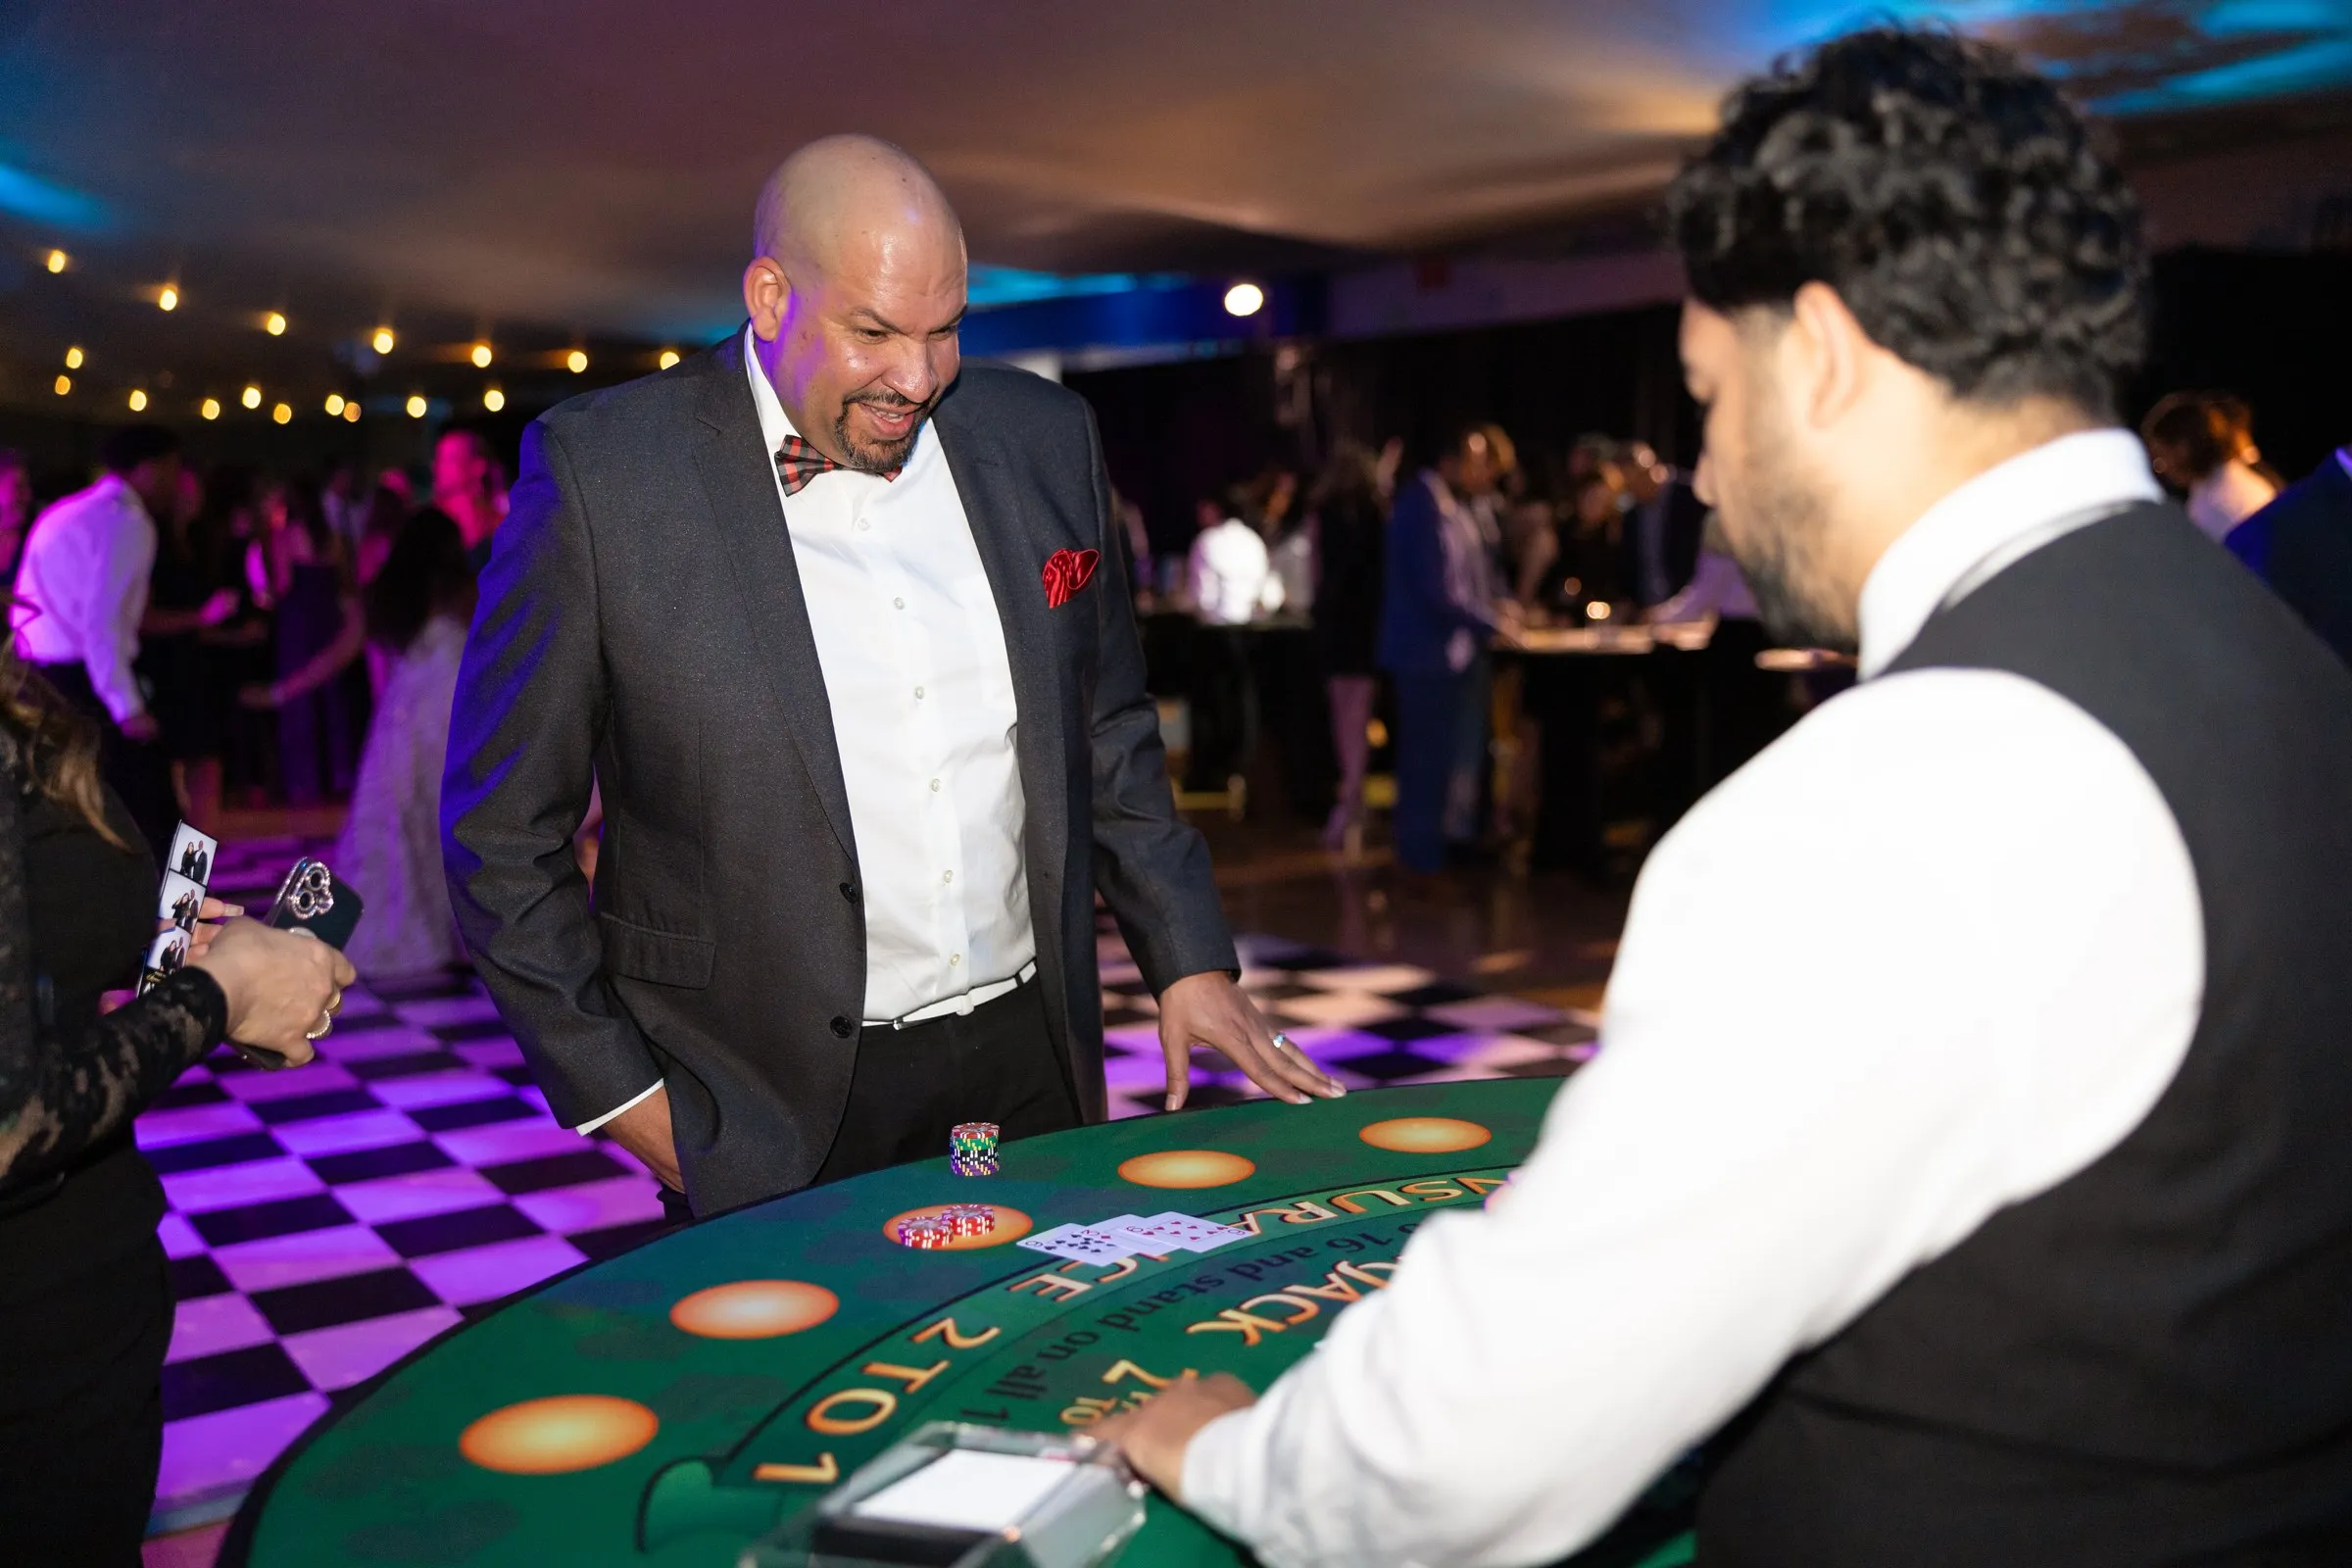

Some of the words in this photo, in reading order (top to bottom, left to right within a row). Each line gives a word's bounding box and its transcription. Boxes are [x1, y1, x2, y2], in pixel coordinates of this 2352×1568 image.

[1326, 1231, 1395, 1254] 16
[1225, 1244, 1320, 1283] and
[1097, 1273, 1226, 1333] stand
[1187, 1255, 1401, 1346] JACK
[909, 1317, 1002, 1349] 2
[1035, 1329, 1101, 1361] on
[804, 1358, 952, 1436] TO
[985, 1363, 1048, 1400] all
[960, 1406, 1009, 1421] 1
[753, 1451, 840, 1484] 1
